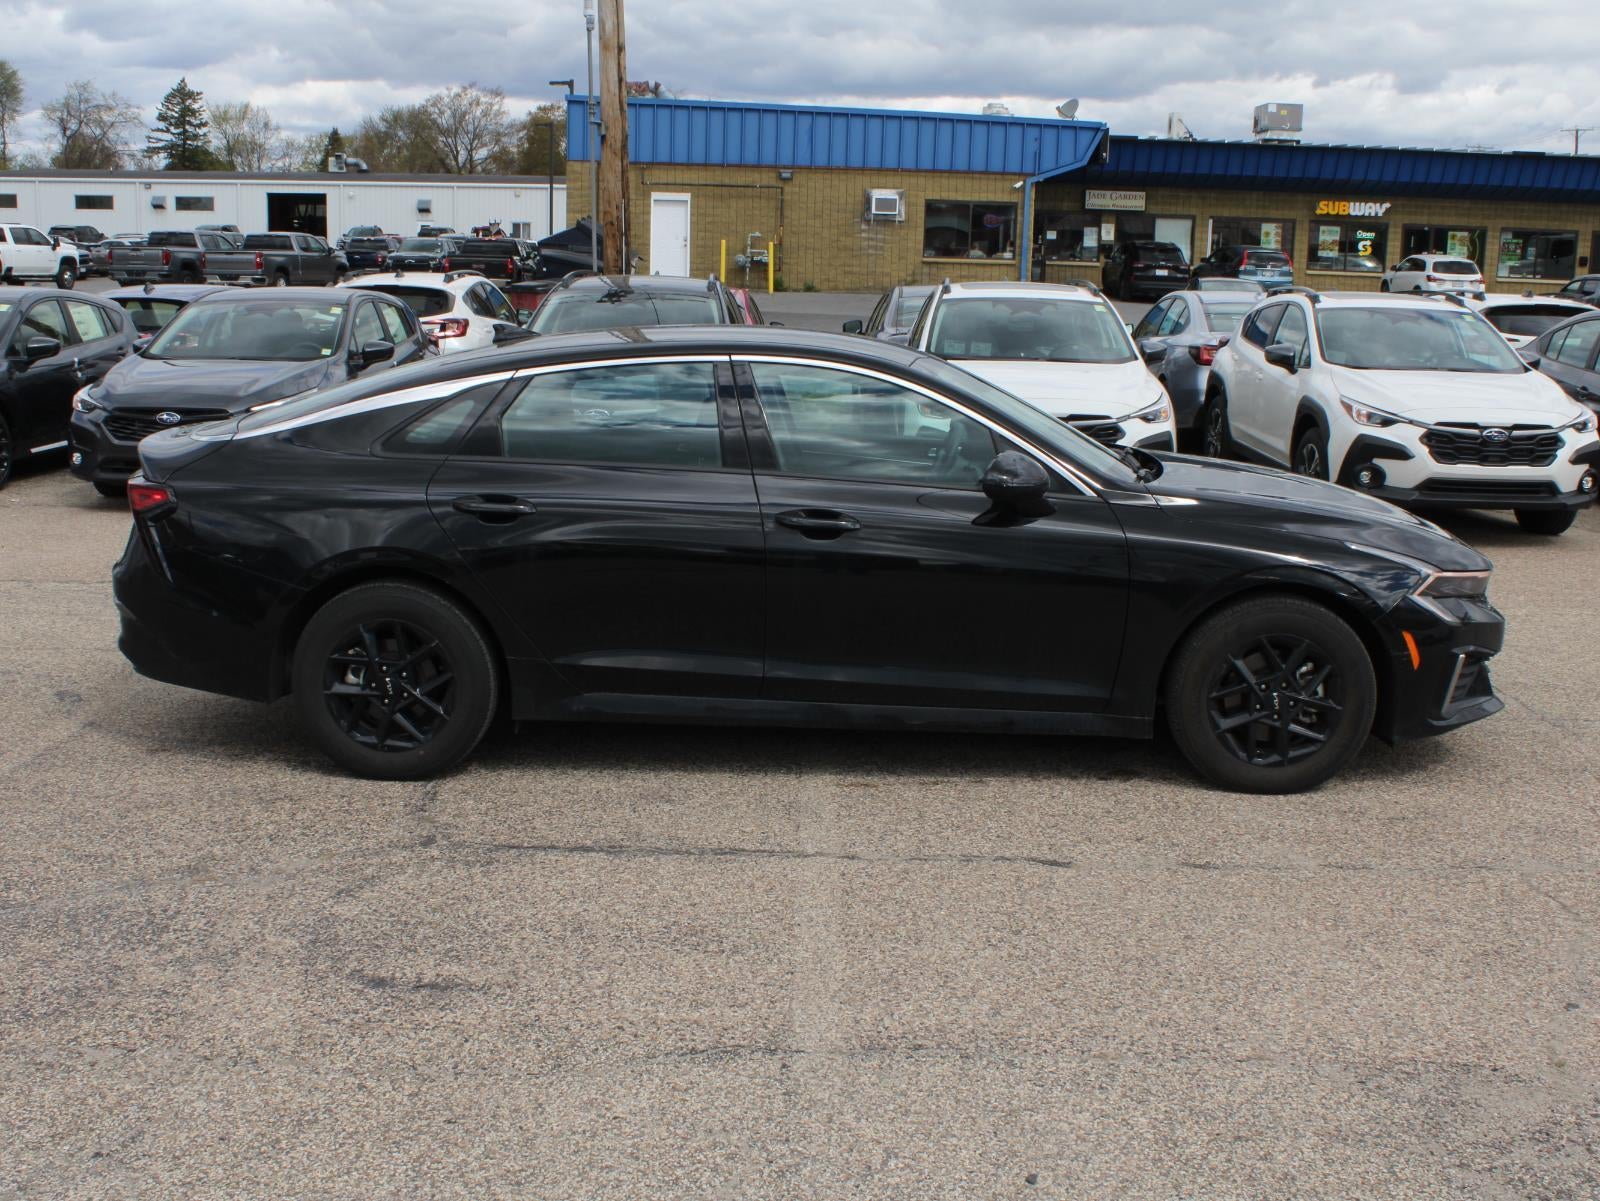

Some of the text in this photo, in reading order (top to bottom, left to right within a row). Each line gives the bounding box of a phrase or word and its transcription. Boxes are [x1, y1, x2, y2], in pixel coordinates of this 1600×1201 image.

[1088, 191, 1145, 201] JADE GARDEN
[1315, 200, 1392, 217] SUBWAY
[1356, 230, 1375, 238] Open
